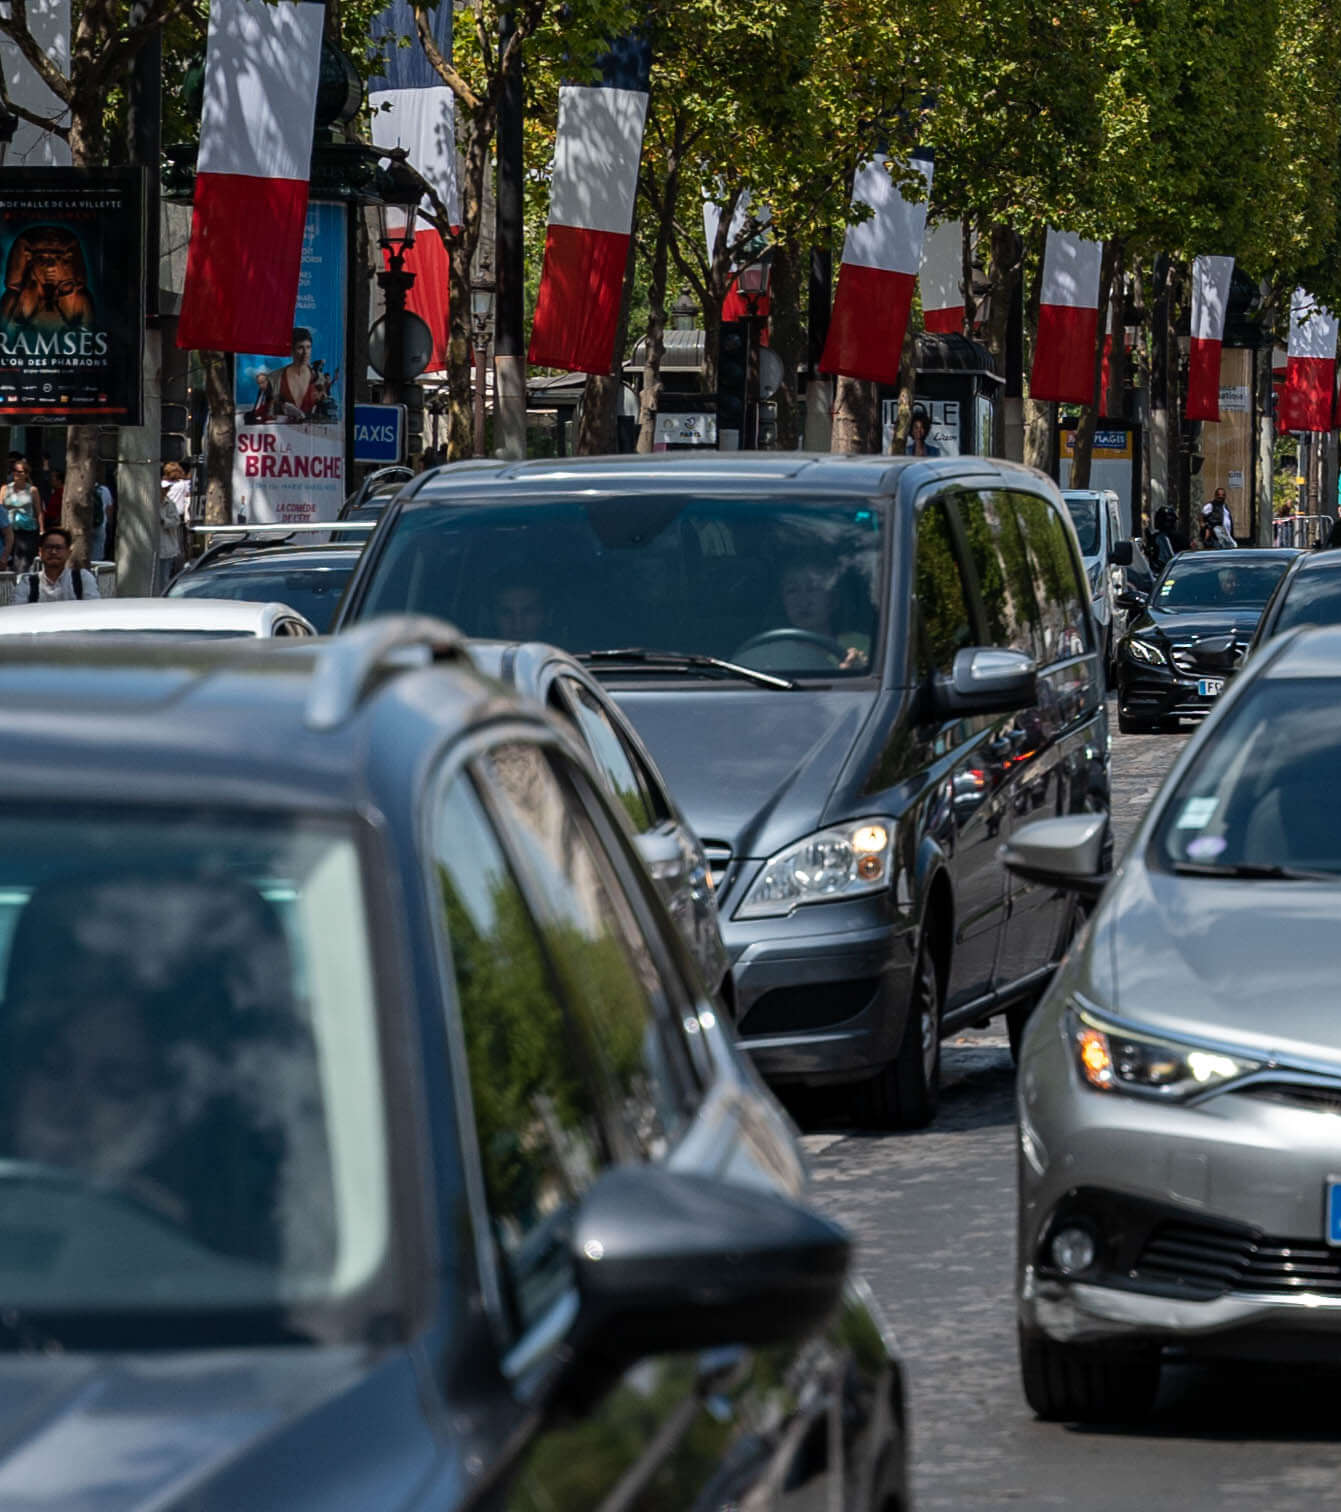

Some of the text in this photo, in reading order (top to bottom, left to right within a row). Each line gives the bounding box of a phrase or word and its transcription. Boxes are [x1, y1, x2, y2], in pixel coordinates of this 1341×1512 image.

[0, 327, 108, 355] RAMSÈS
[28, 358, 48, 366] DES
[51, 358, 108, 366] PHARAONS
[237, 433, 277, 453] SUR
[354, 425, 395, 442] TAXIS
[245, 455, 341, 479] BRANCHE
